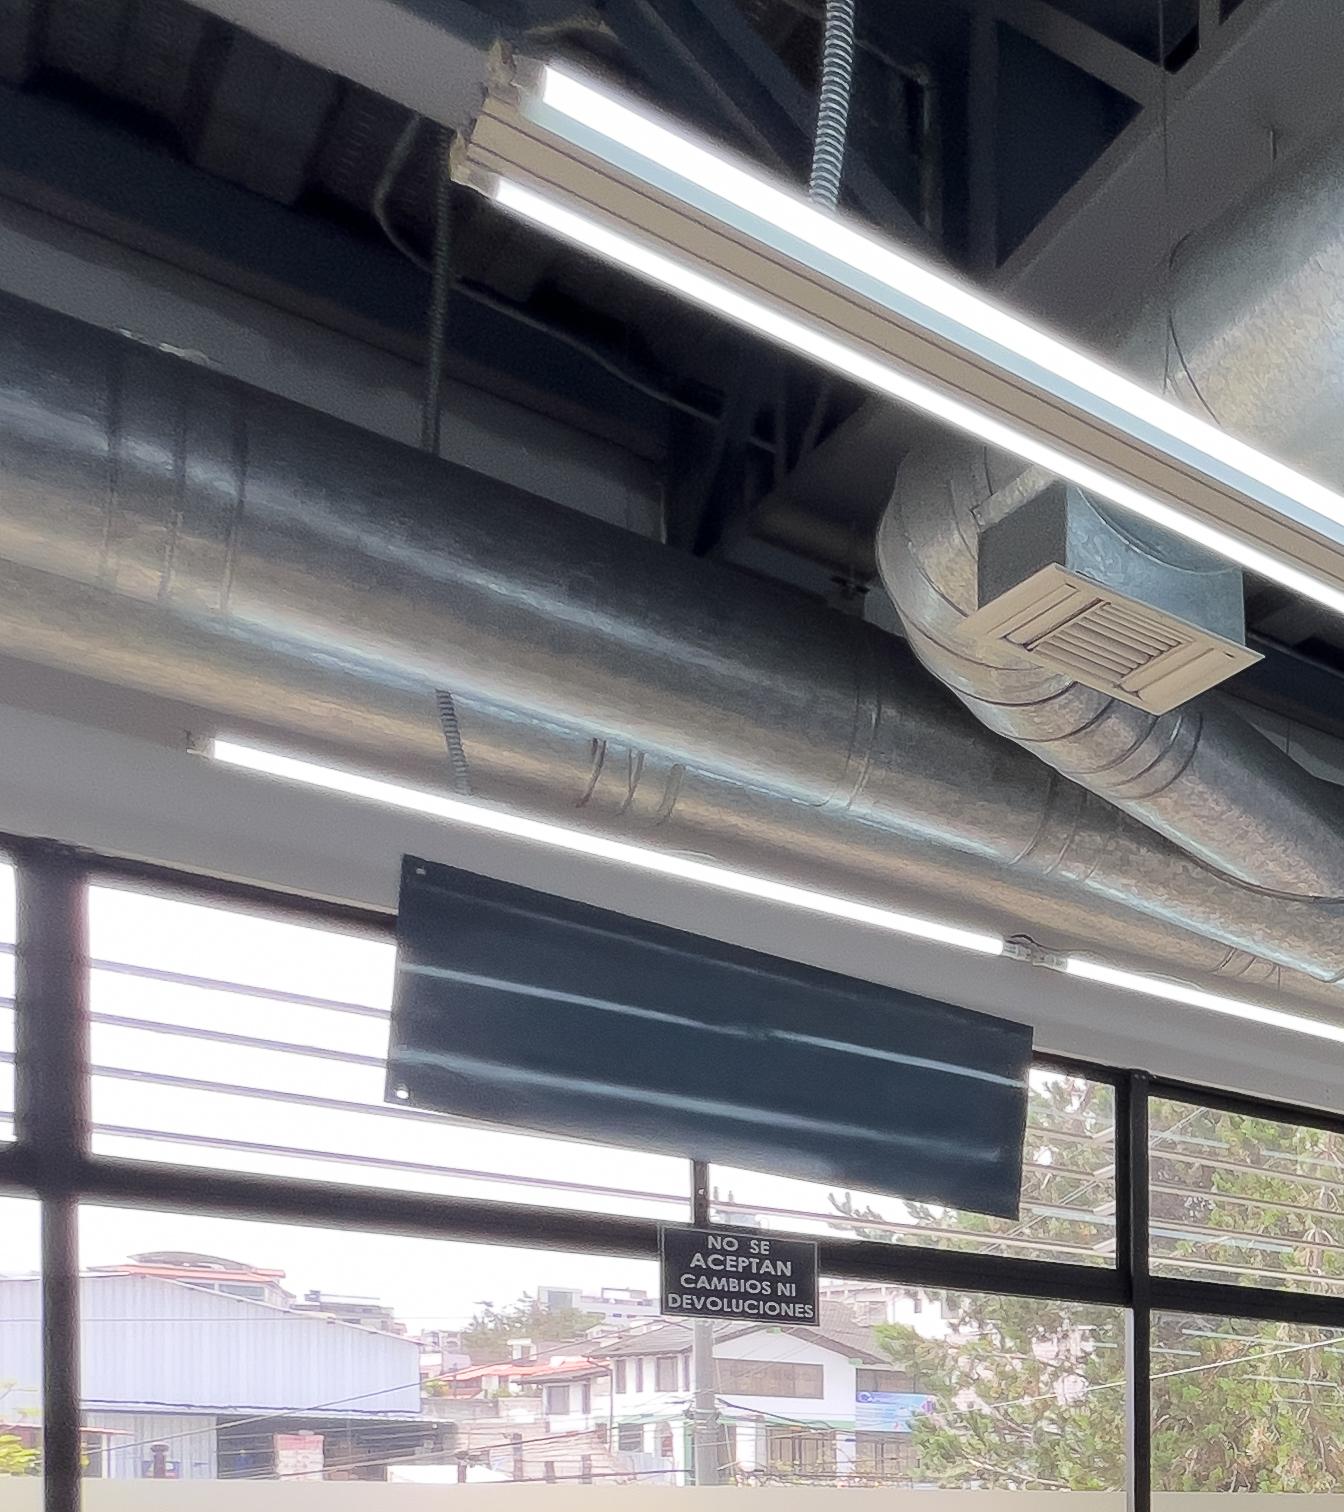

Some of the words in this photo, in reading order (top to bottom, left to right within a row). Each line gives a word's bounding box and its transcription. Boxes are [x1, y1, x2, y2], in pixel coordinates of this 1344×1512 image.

[707, 1235, 739, 1251] NO
[749, 1239, 770, 1254] SE
[689, 1252, 792, 1276] ACEPTAN
[680, 1273, 771, 1295] CAMBIOS
[777, 1282, 796, 1297] NI
[667, 1293, 814, 1318] DEVOLUCIONES
